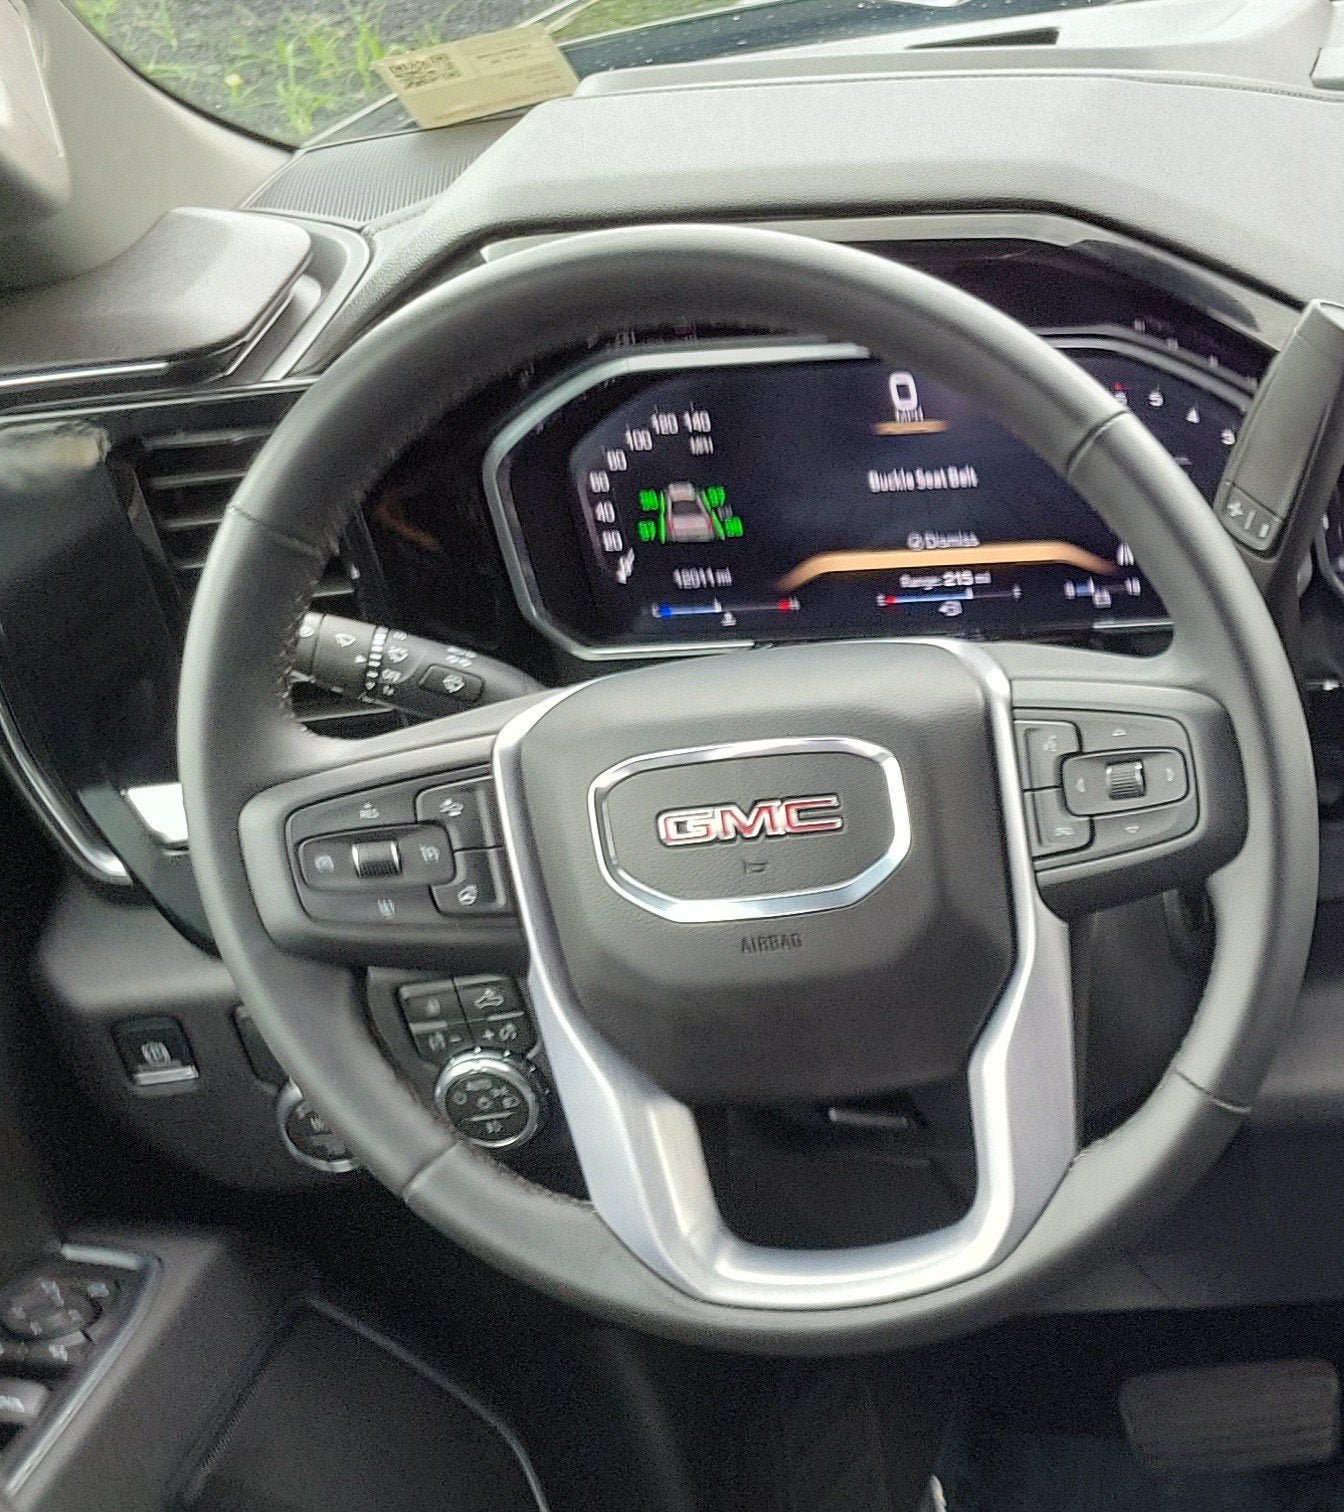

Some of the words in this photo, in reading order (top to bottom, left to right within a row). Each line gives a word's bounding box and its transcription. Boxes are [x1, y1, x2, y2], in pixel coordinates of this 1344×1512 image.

[888, 370, 919, 411] 0
[947, 464, 978, 489] Belt
[656, 793, 844, 847] GMC
[741, 933, 803, 954] AIRBAG
